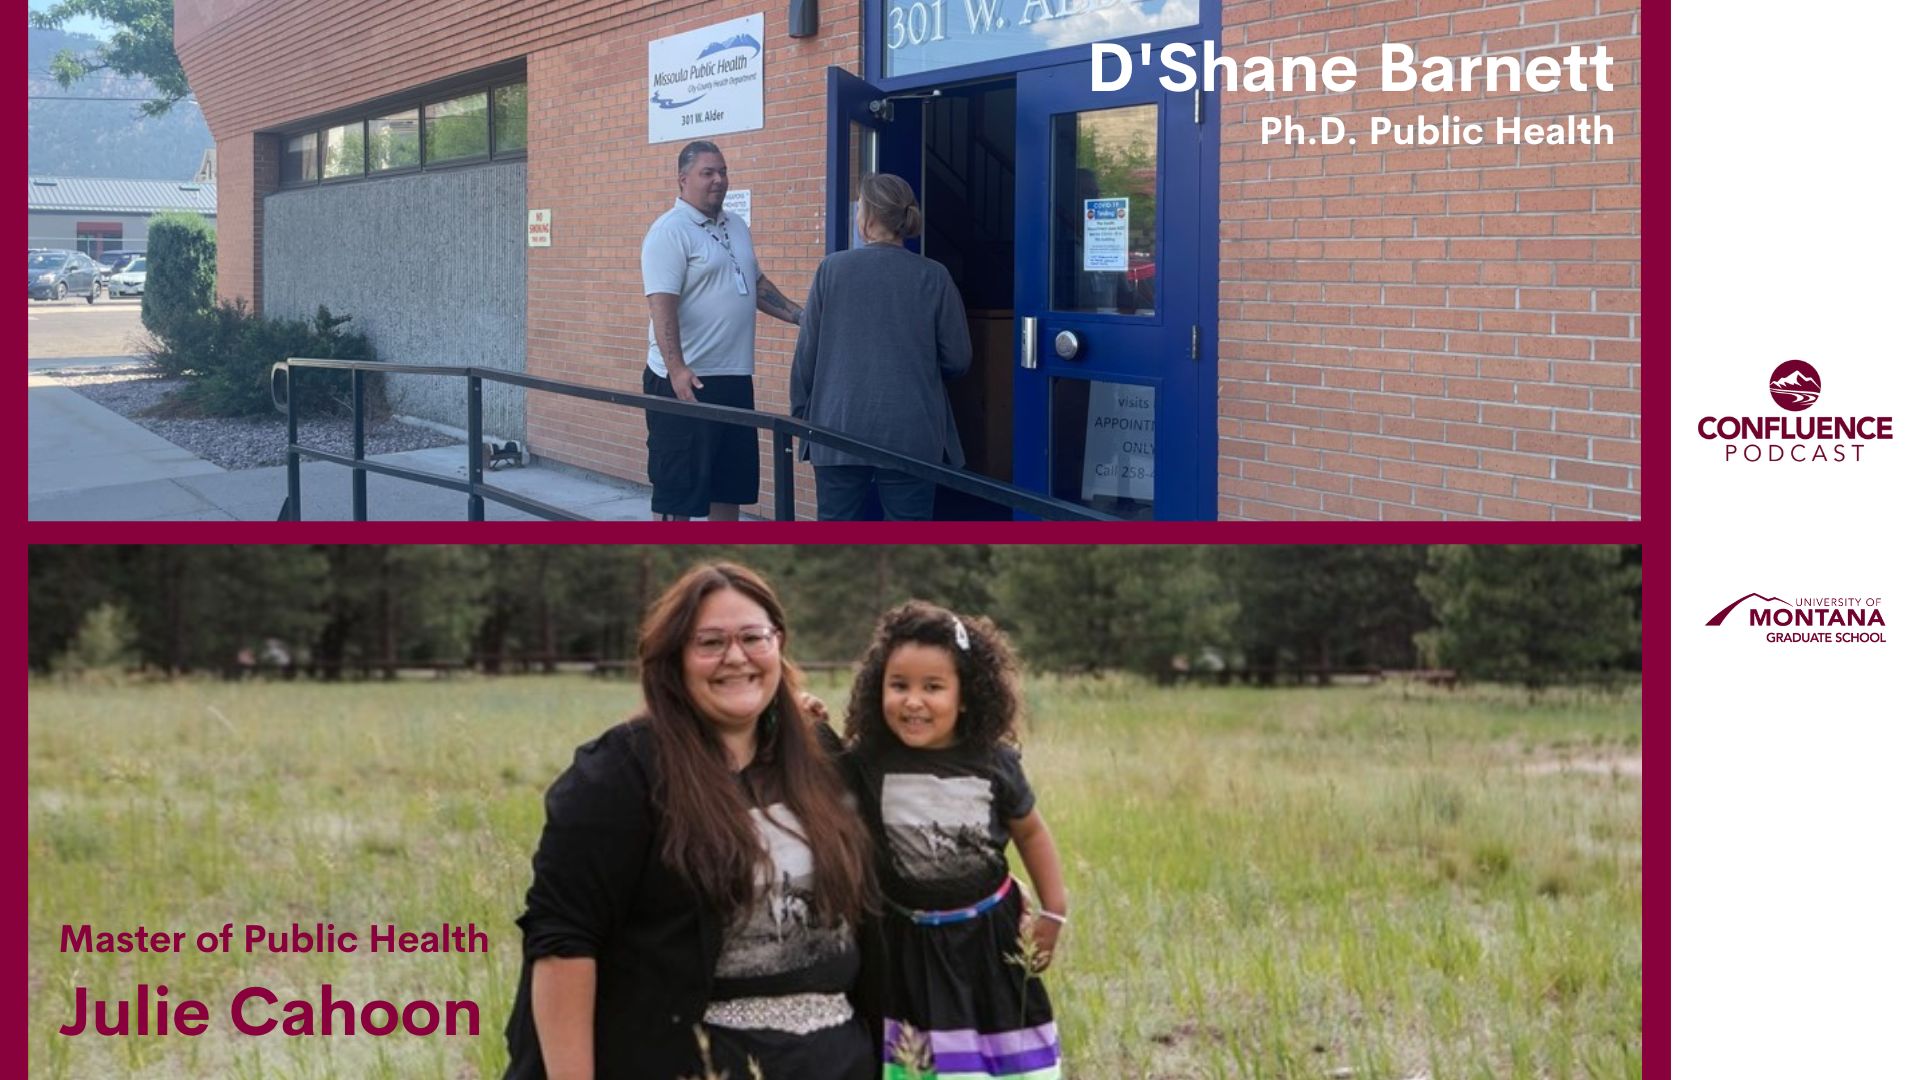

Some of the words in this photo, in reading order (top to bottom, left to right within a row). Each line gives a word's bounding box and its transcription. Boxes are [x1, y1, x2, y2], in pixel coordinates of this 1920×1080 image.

[888, 0, 946, 49] 301
[653, 68, 689, 88] Missoula
[690, 61, 717, 80] Public
[717, 54, 748, 75] Health
[728, 72, 757, 86] Department
[681, 114, 694, 126] 301
[695, 112, 704, 124] W.
[704, 109, 725, 122] Alder
[529, 223, 549, 233] SMOKING
[1118, 395, 1150, 409] visits
[1094, 415, 1155, 432] APPOINT
[1095, 463, 1117, 477] Call
